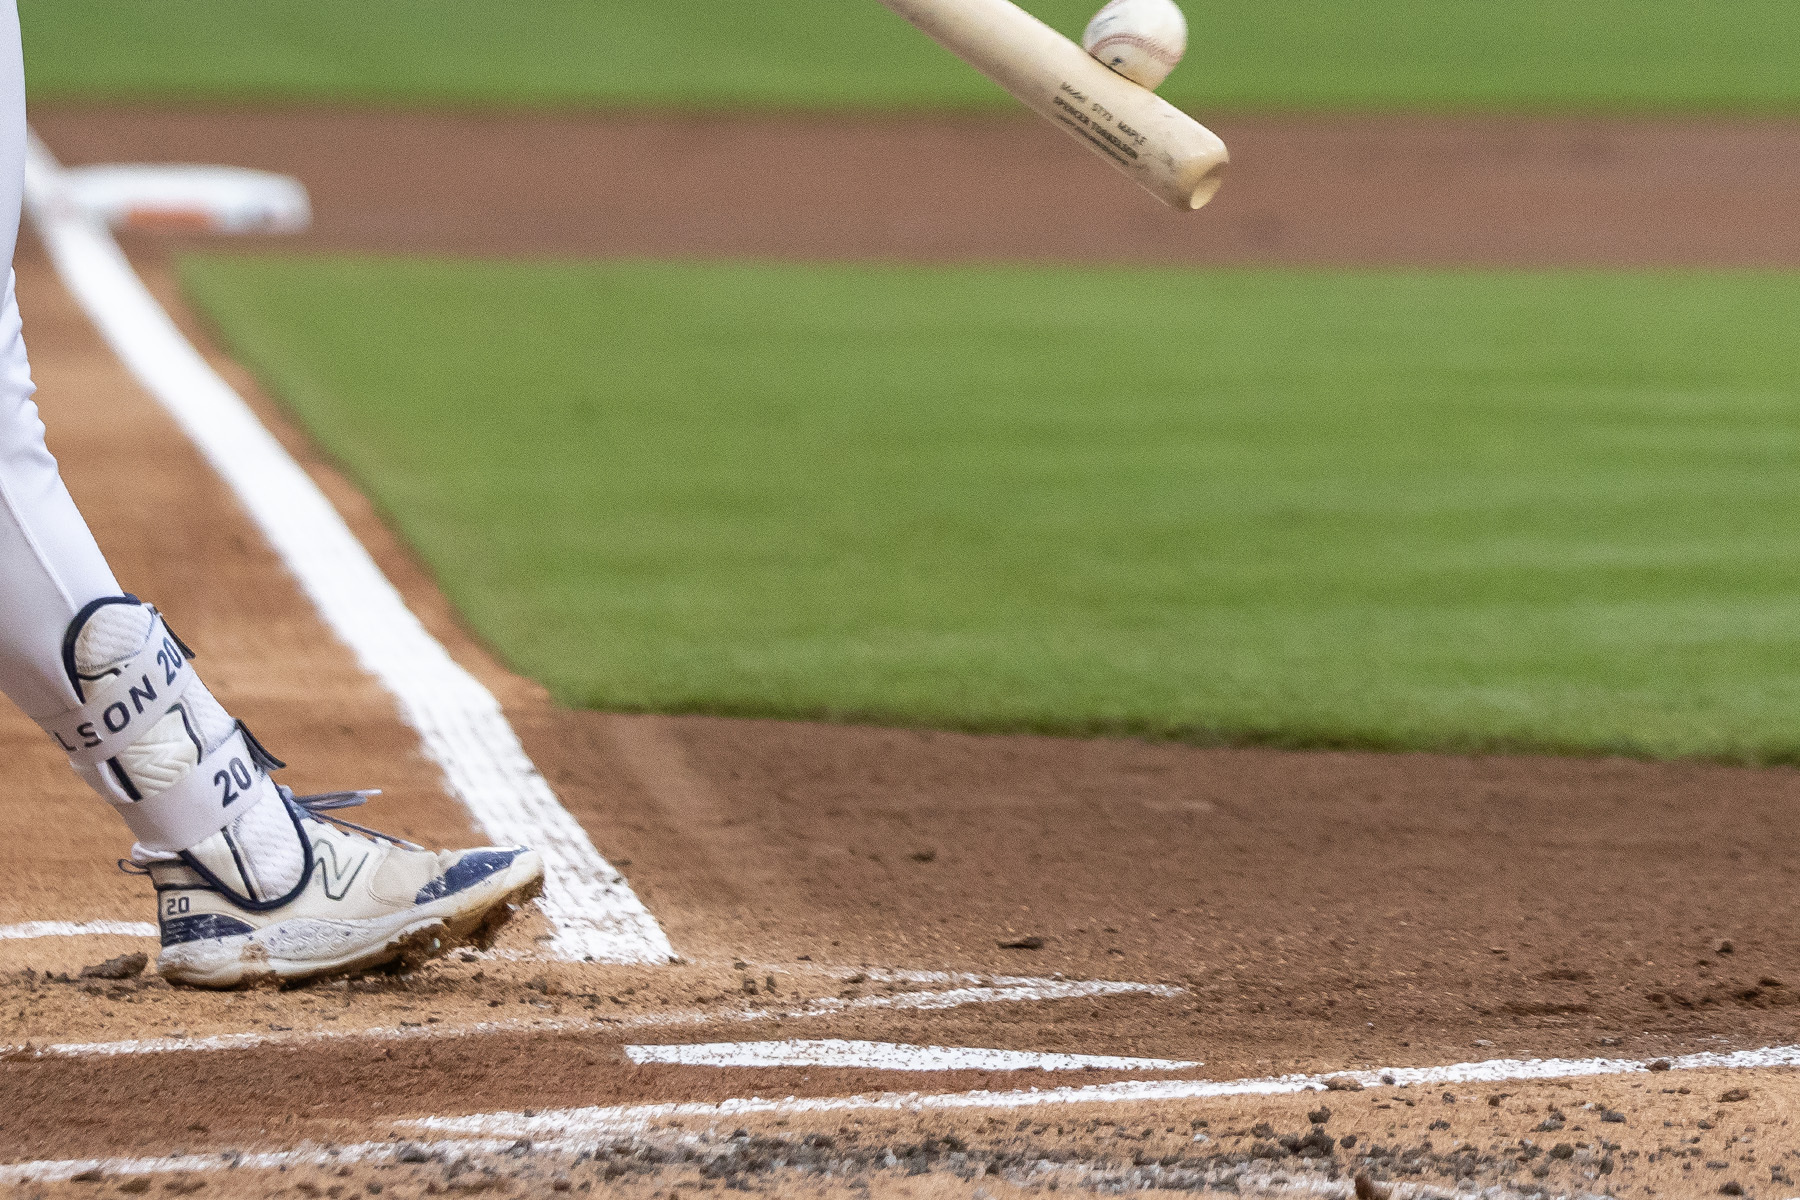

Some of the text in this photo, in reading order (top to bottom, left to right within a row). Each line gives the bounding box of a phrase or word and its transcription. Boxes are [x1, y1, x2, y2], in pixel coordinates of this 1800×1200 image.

[156, 636, 183, 687] 20
[213, 756, 252, 809] 20
[165, 895, 191, 917] 20
